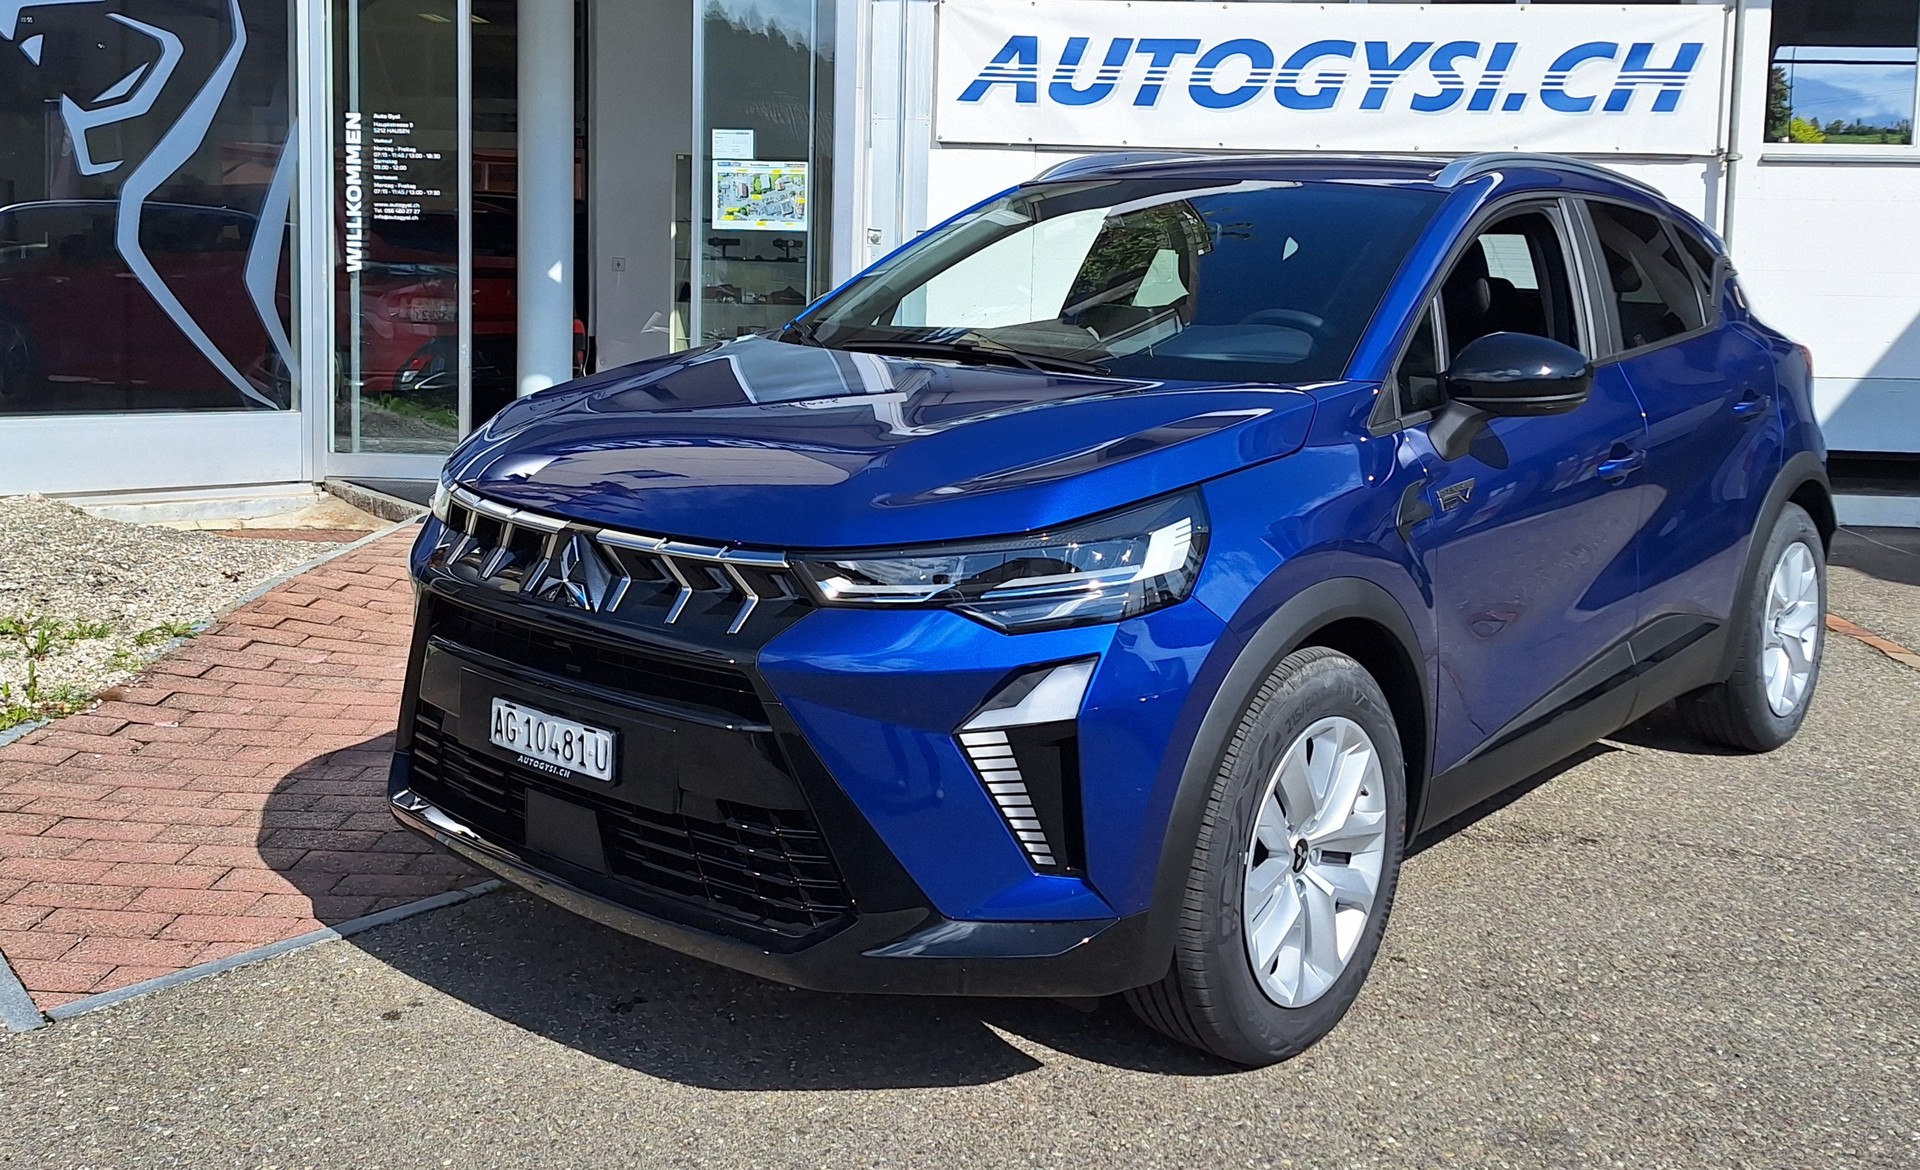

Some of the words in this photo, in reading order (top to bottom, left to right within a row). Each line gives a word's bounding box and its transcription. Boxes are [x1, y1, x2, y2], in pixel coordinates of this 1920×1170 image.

[956, 35, 1705, 114] AUTOGYSI.CH
[345, 112, 362, 273] WILLKOMMEN
[517, 755, 571, 778] AUTOGYSI.CH
